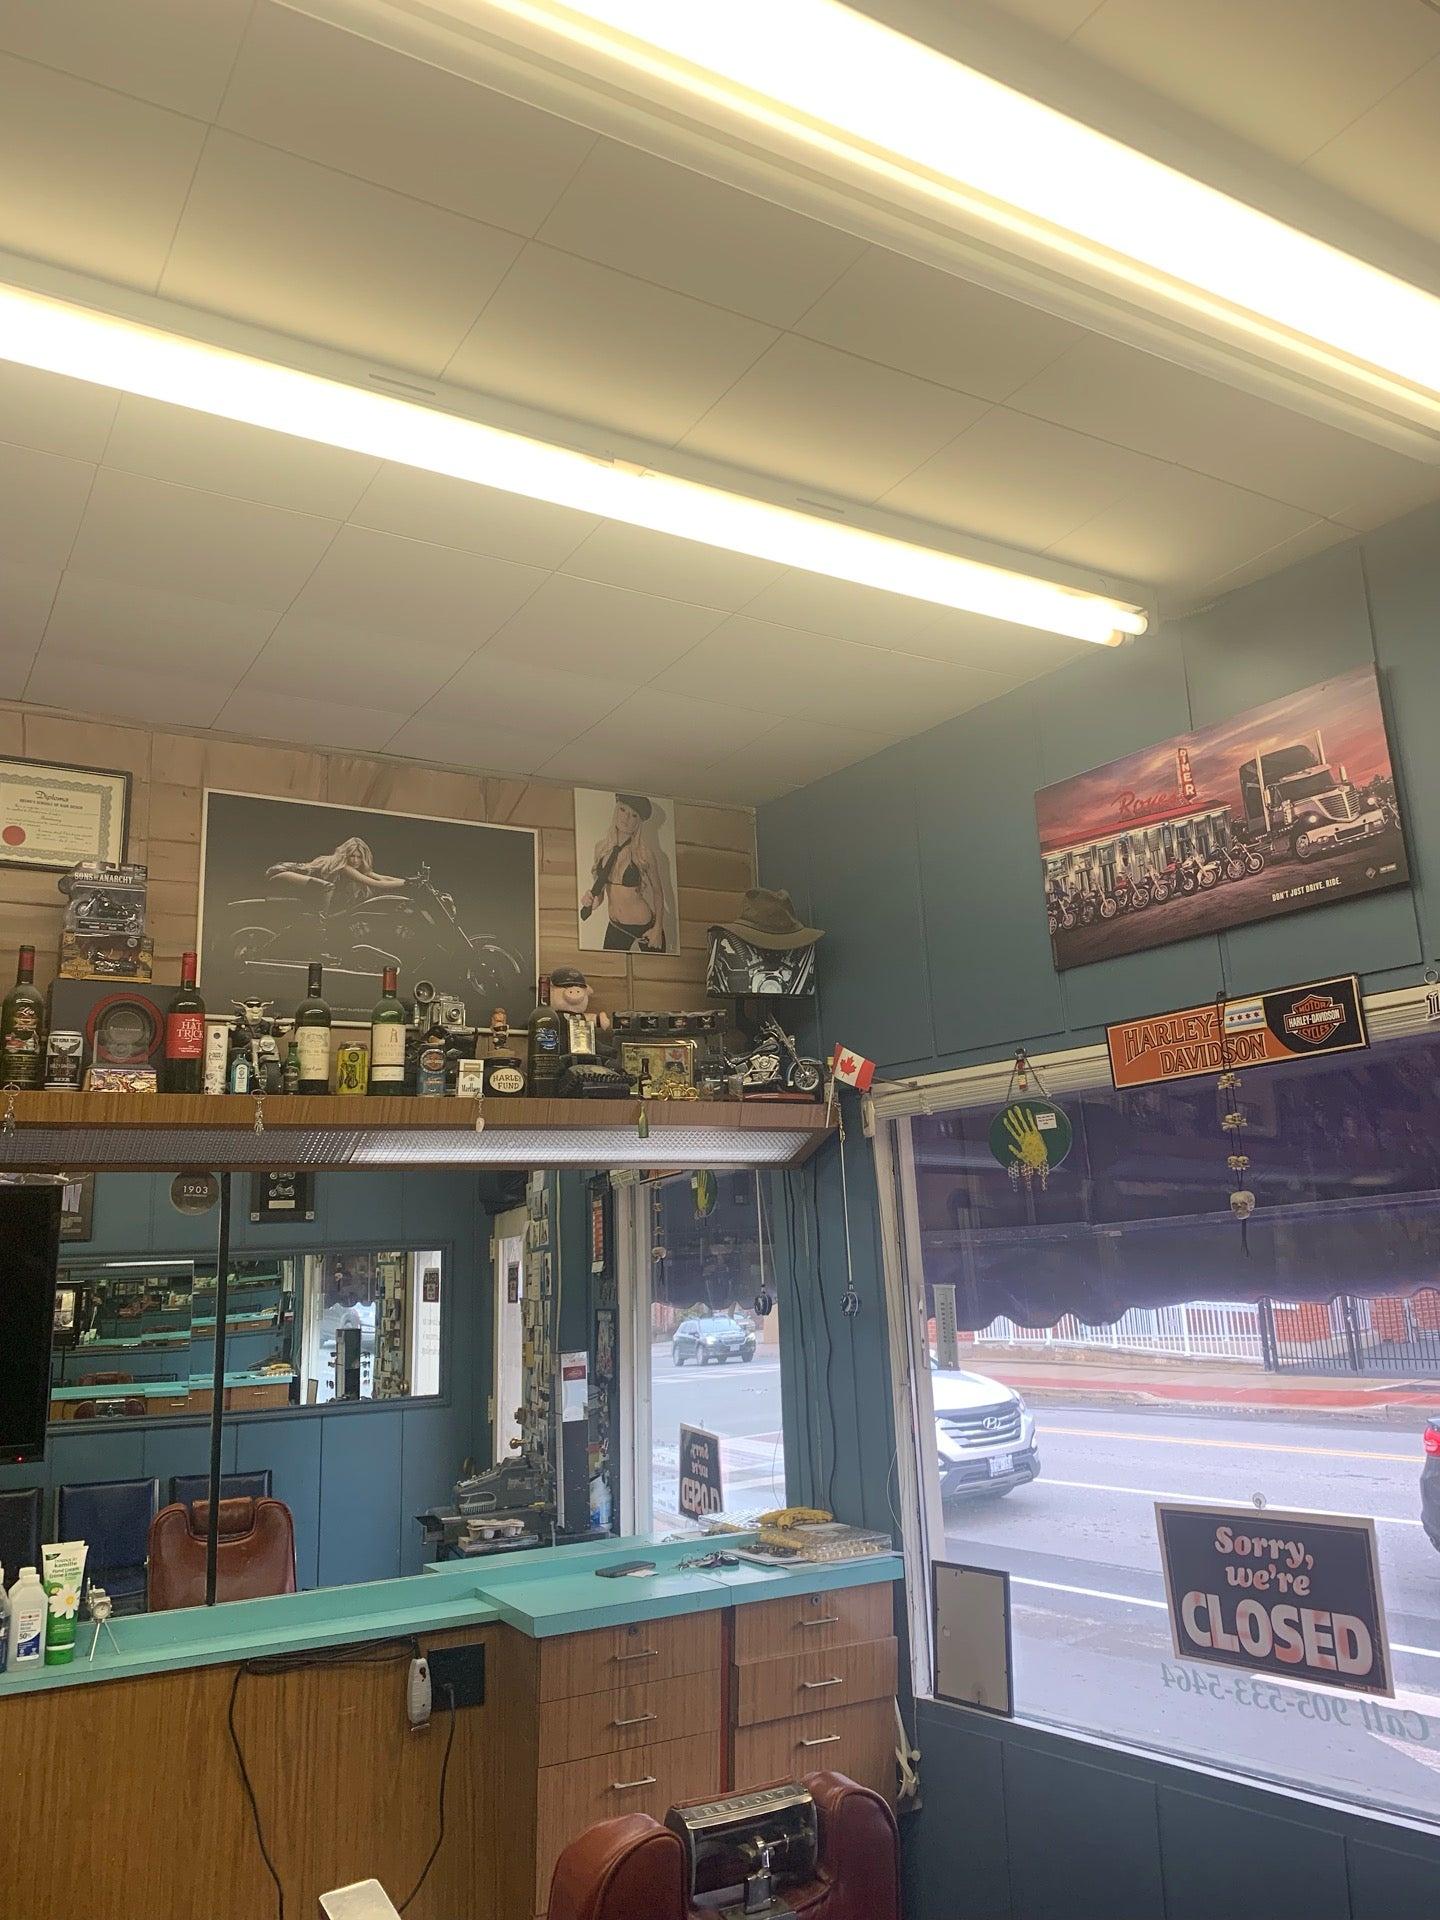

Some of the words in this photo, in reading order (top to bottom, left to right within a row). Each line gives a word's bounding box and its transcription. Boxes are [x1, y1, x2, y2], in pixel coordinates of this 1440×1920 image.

[1179, 749, 1195, 796] DINER
[74, 872, 94, 880] SONS
[99, 874, 133, 884] ANARCHY
[1272, 892, 1290, 902] DON'T
[1290, 886, 1305, 897] JUST
[1298, 1000, 1327, 1013] MOTOR
[182, 1021, 203, 1030] HAT
[1288, 1009, 1340, 1028] HARLEY-DAVIDSON
[1301, 1023, 1331, 1038] CYCLES
[1159, 1033, 1267, 1076] DAVIDSON
[497, 1082, 519, 1090] FUND
[183, 1185, 209, 1194] 1903
[1215, 1526, 1315, 1570] Sorry,
[1225, 1563, 1311, 1596] we're
[1181, 1590, 1373, 1676] CLOSED
